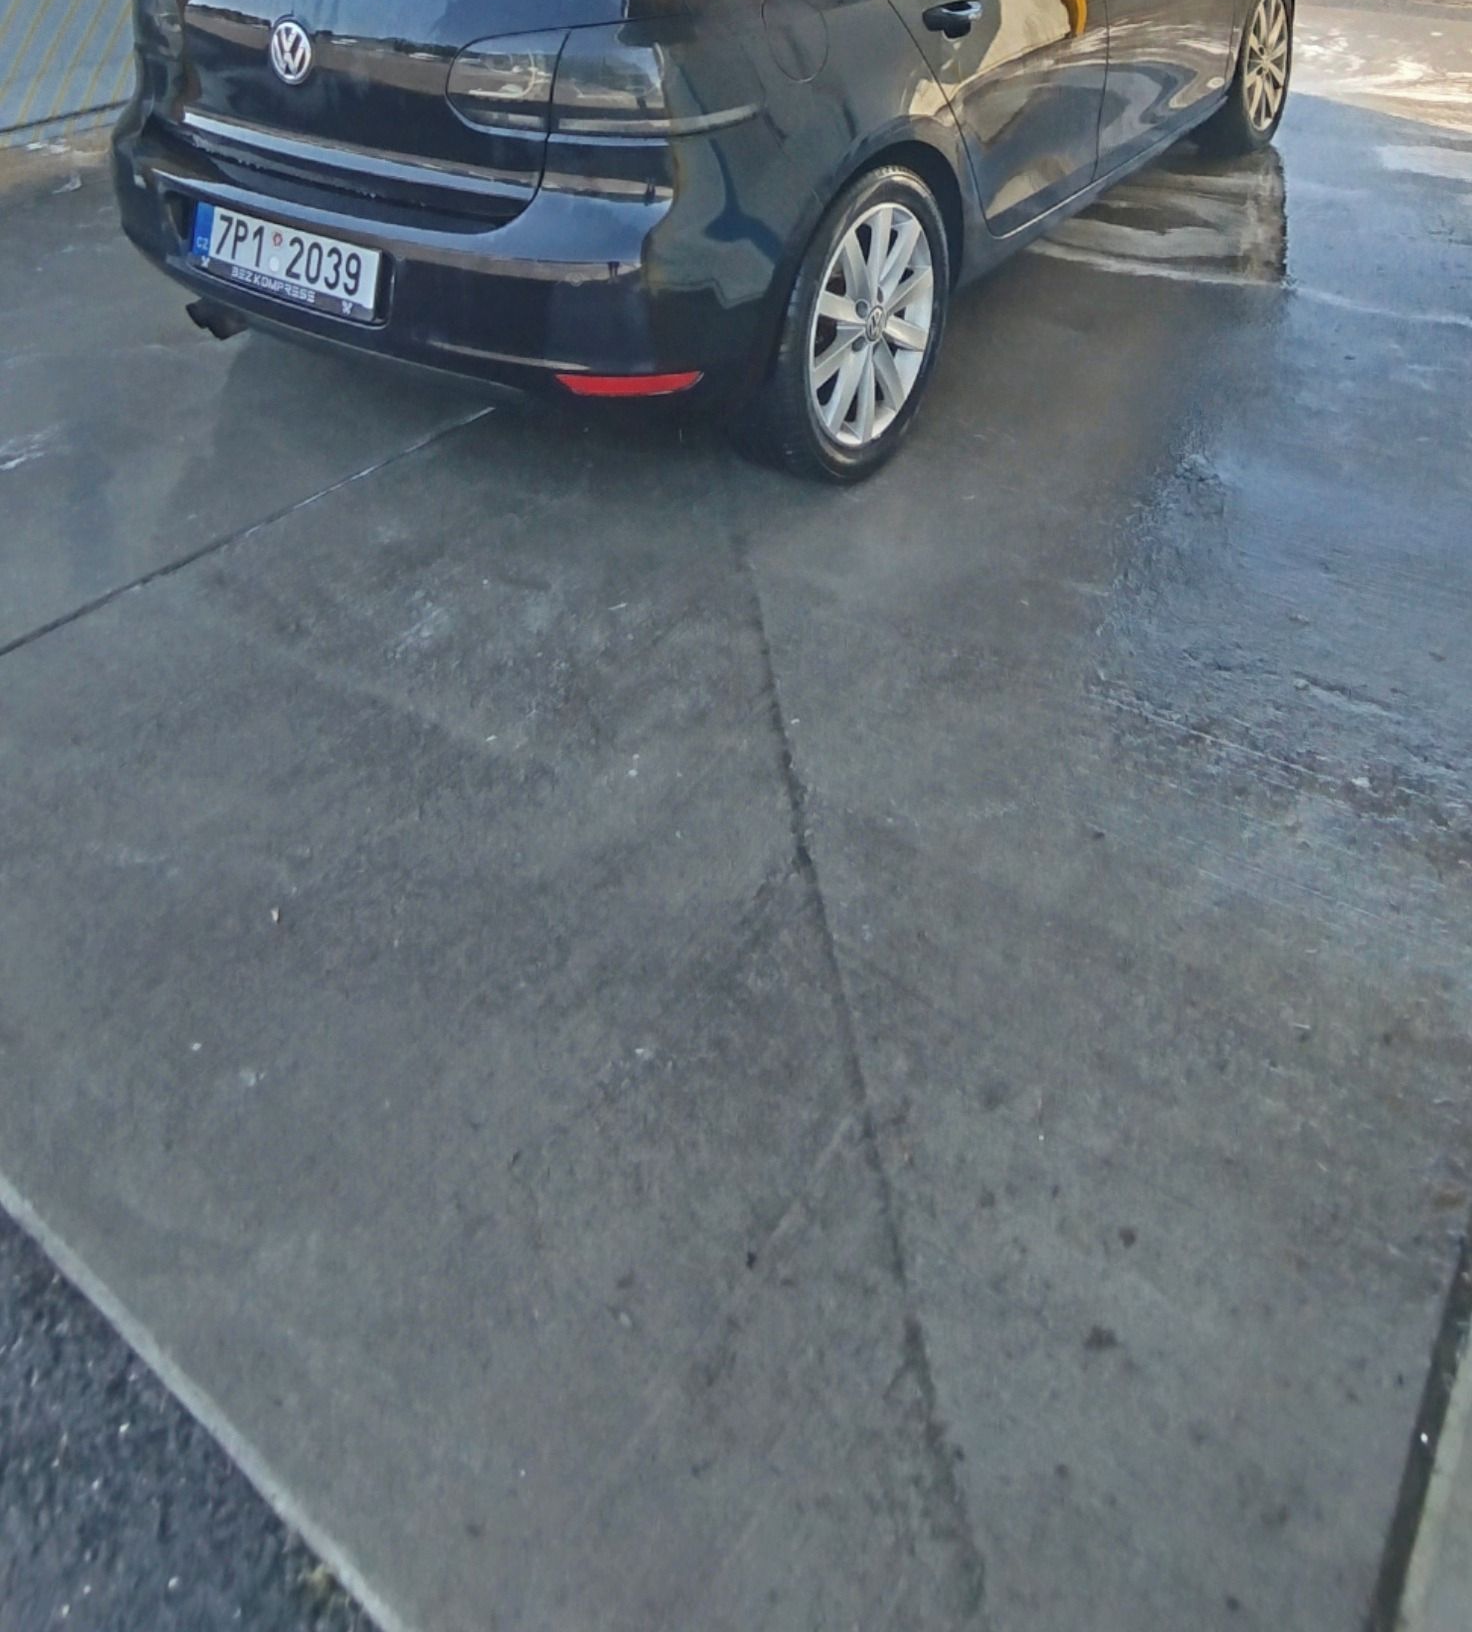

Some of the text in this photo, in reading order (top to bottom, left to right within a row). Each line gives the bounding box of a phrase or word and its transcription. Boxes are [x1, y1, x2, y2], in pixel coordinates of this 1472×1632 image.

[196, 236, 209, 251] CZ
[215, 214, 362, 296] 7P1 2039
